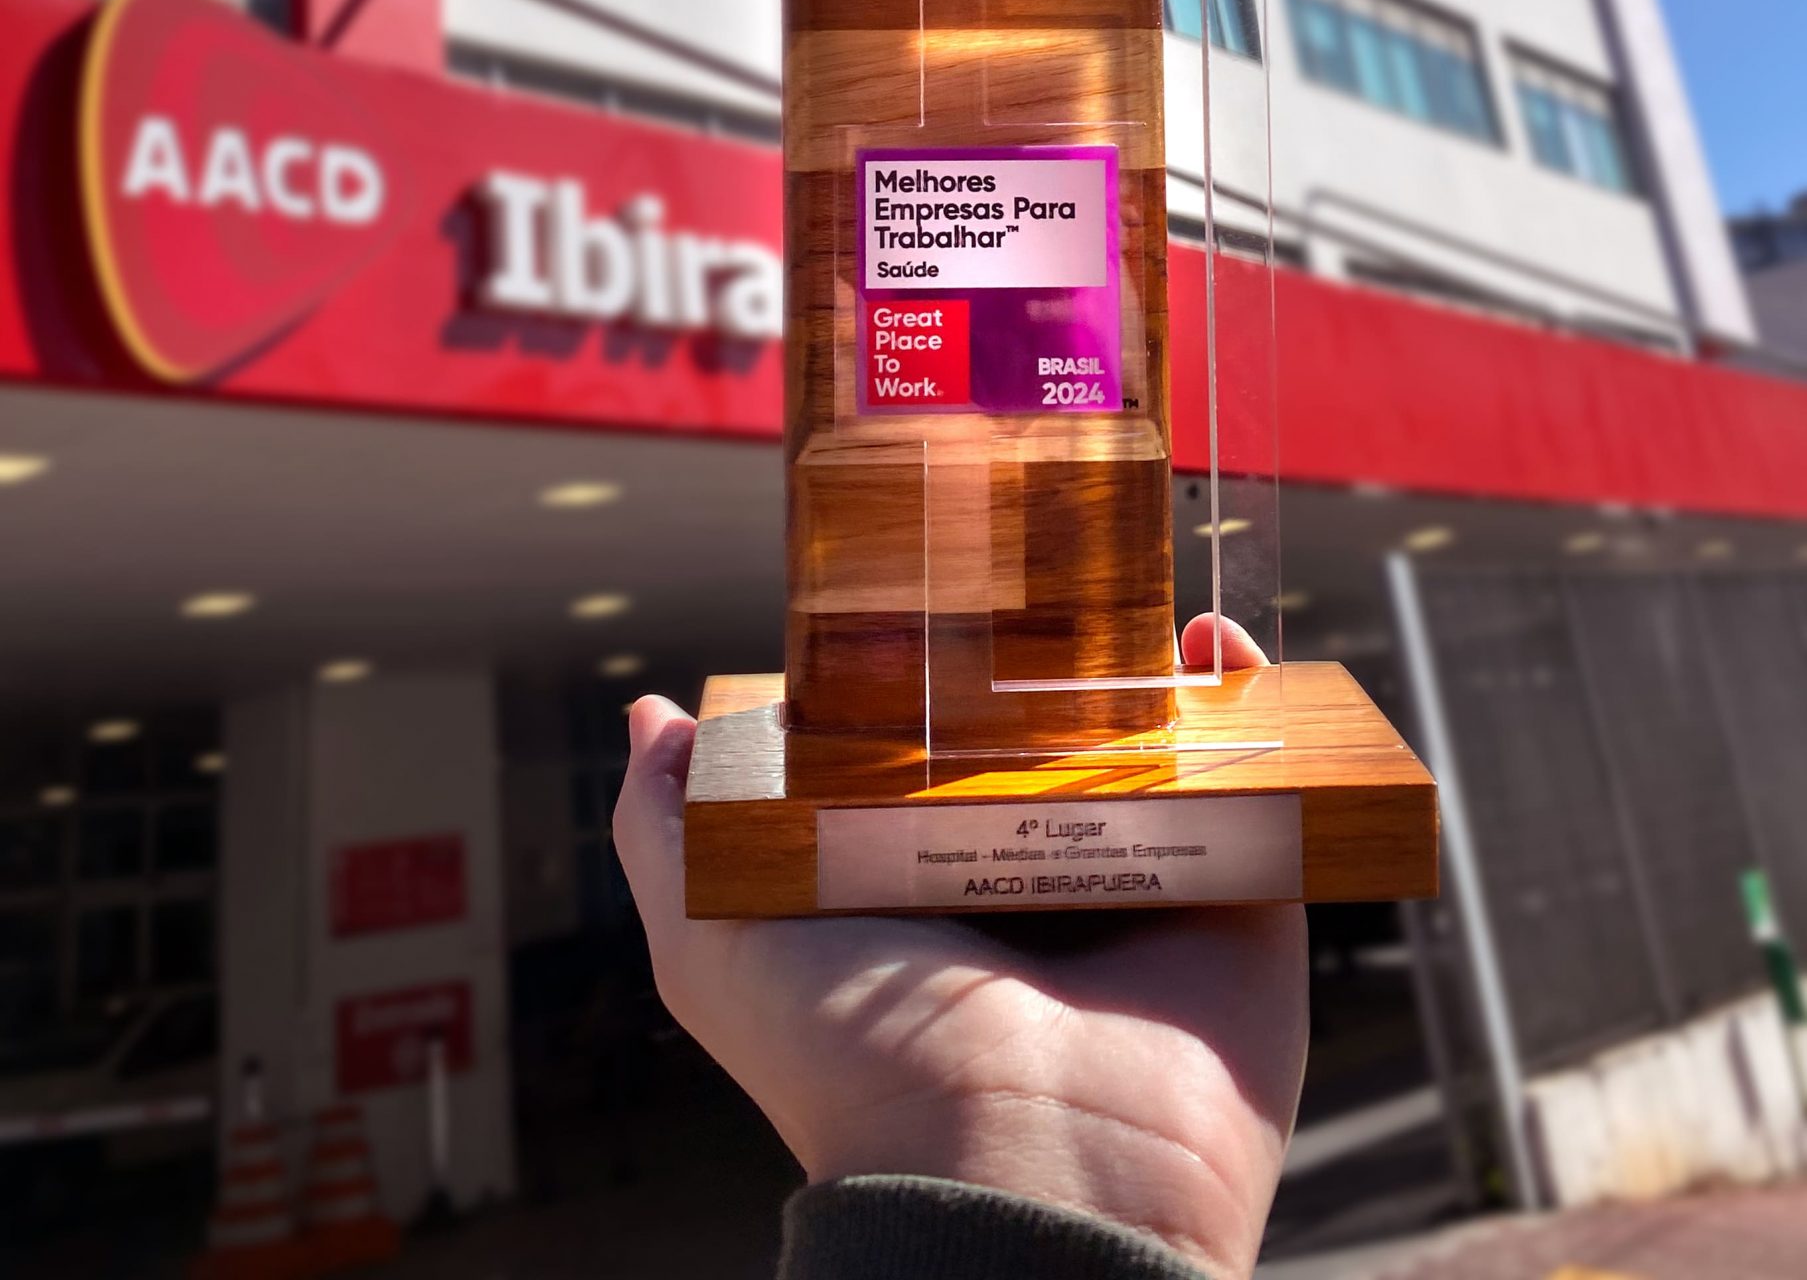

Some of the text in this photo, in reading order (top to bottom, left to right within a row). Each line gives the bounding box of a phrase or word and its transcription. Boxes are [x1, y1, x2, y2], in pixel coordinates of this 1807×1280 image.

[120, 116, 386, 226] AACD
[875, 169, 996, 193] Melhores
[874, 197, 1076, 226] Empresas Para
[877, 261, 939, 278] Saúde
[873, 307, 943, 328] Great
[875, 330, 943, 351] Place
[873, 354, 900, 374] To
[1038, 357, 1105, 376] BRASIL
[1041, 381, 1105, 405] 2024
[1046, 819, 1107, 841] Lugar
[917, 850, 977, 864] Hospital
[1065, 846, 1128, 859] Grandes
[1133, 844, 1206, 860] Empresas
[964, 873, 1162, 896] AACD IBIRAPUERA
